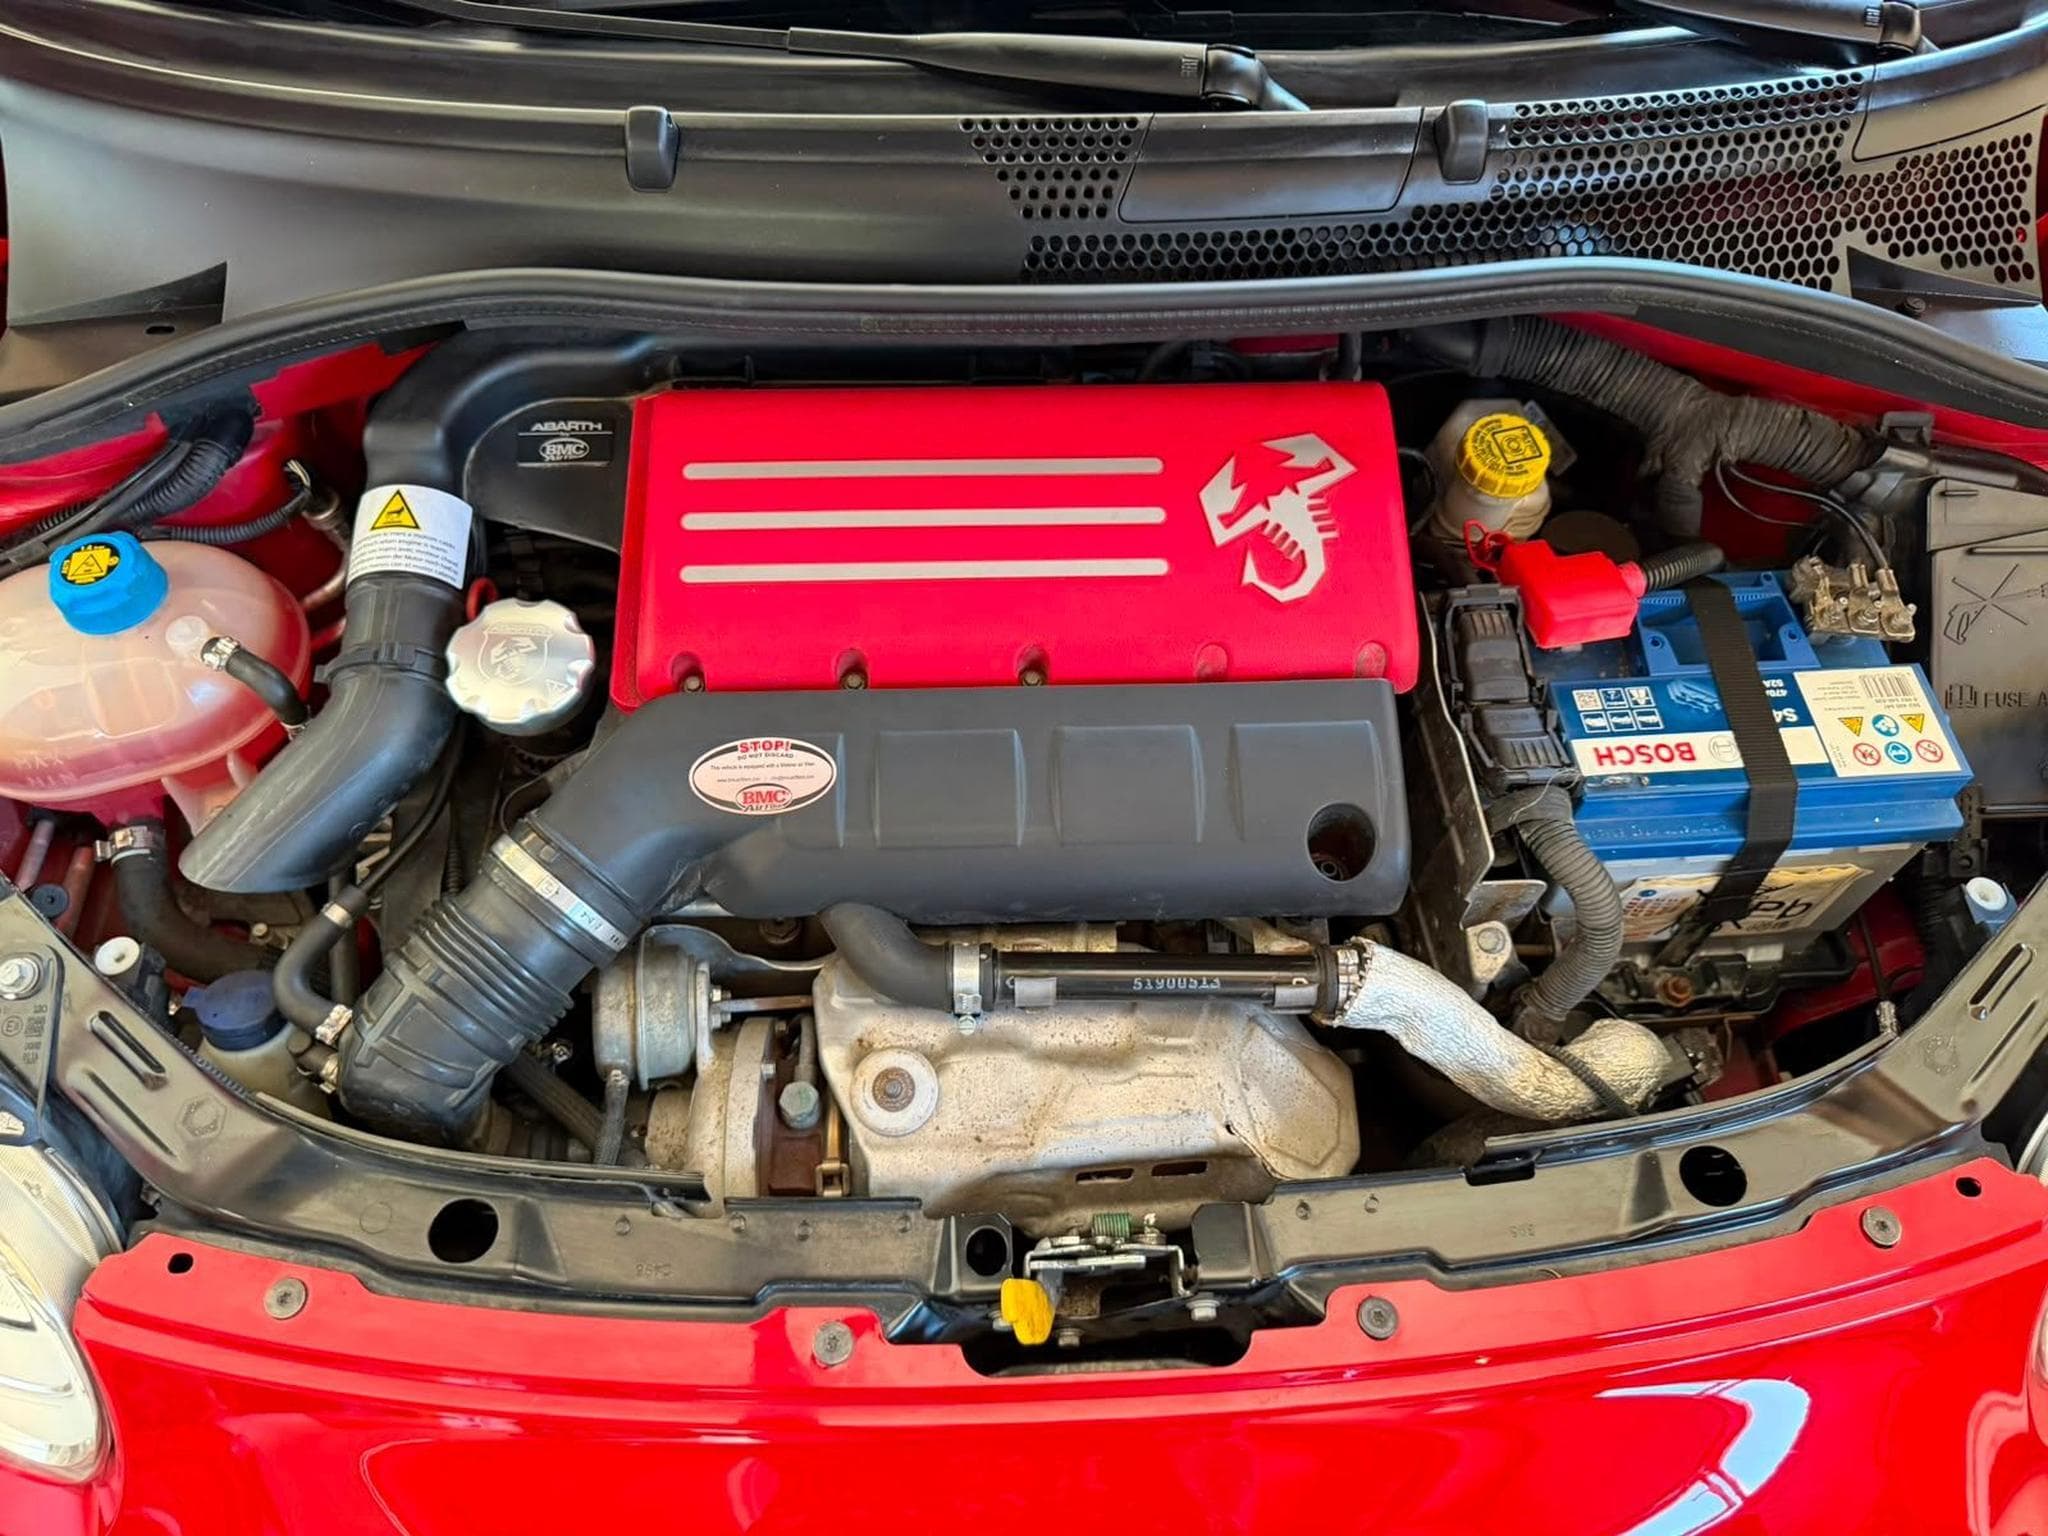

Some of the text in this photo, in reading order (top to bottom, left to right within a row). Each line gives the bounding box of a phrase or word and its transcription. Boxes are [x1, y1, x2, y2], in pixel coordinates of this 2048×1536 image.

[531, 420, 602, 431] ABARTH
[546, 444, 585, 455] BMC
[1984, 691, 2029, 708] FUSE
[740, 740, 790, 753] STOP!
[1593, 742, 1696, 766] BOSCH
[743, 790, 786, 804] BMC
